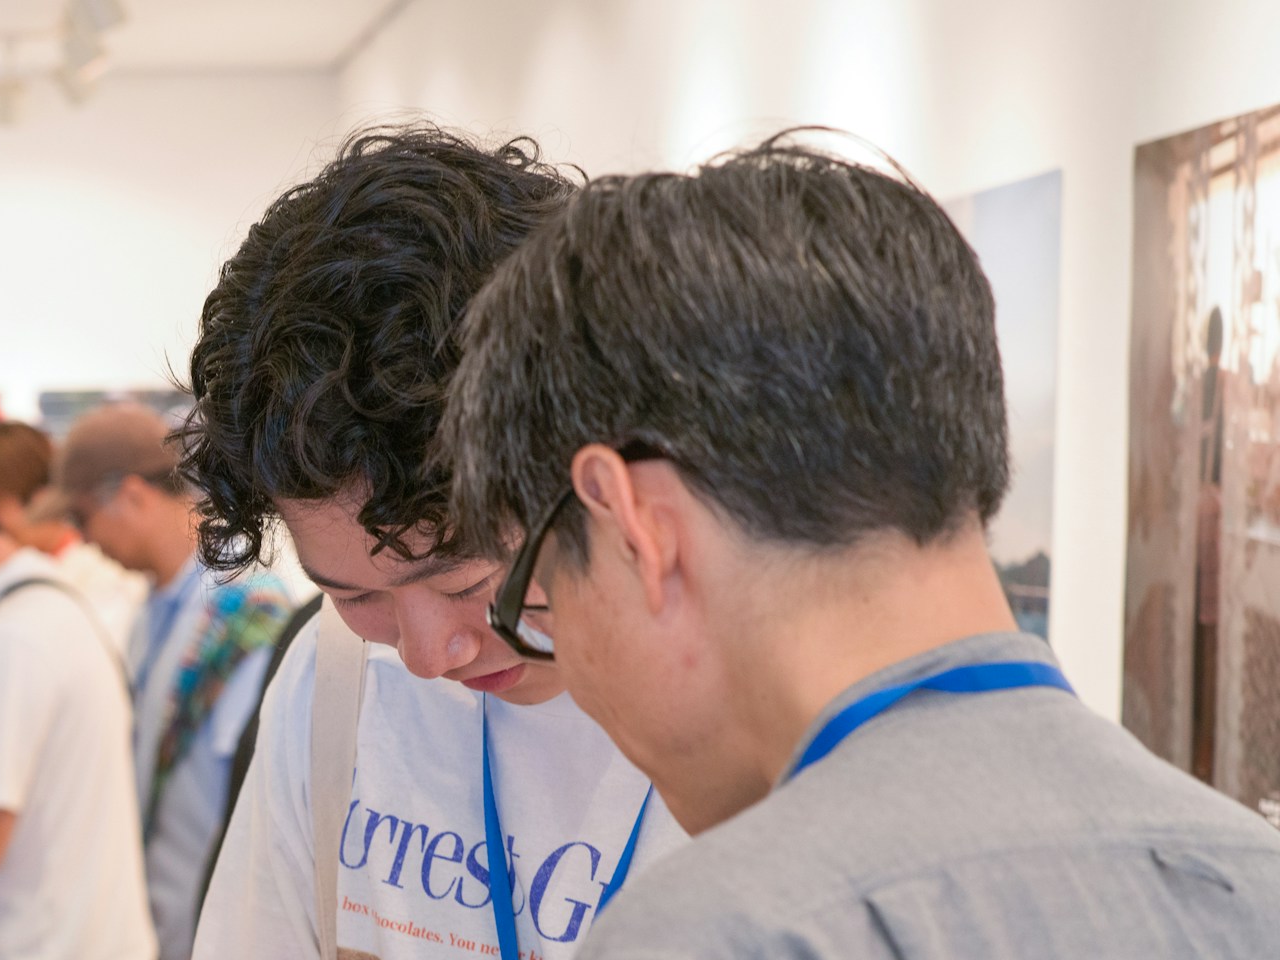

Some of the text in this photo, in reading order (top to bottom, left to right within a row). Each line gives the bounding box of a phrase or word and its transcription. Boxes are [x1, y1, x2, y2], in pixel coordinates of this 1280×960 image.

[339, 799, 609, 943] orrest G
[342, 896, 369, 916] box
[449, 932, 477, 951] You
